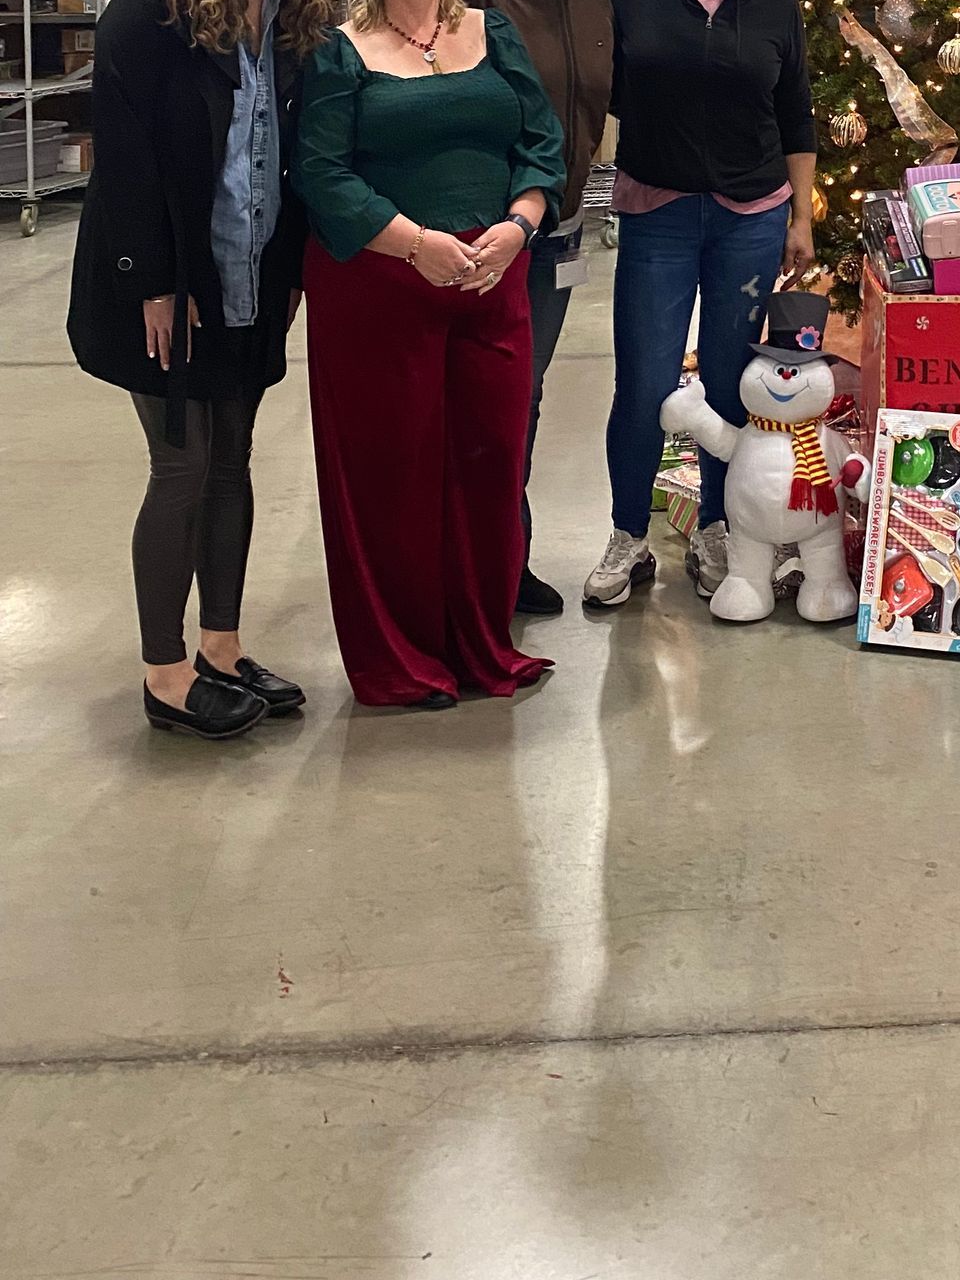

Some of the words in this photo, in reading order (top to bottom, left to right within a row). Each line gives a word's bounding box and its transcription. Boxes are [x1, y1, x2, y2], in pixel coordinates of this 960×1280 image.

[875, 448, 888, 486] JUMBO
[870, 488, 884, 547] COOKWARE
[865, 548, 878, 597] PLAYSET
